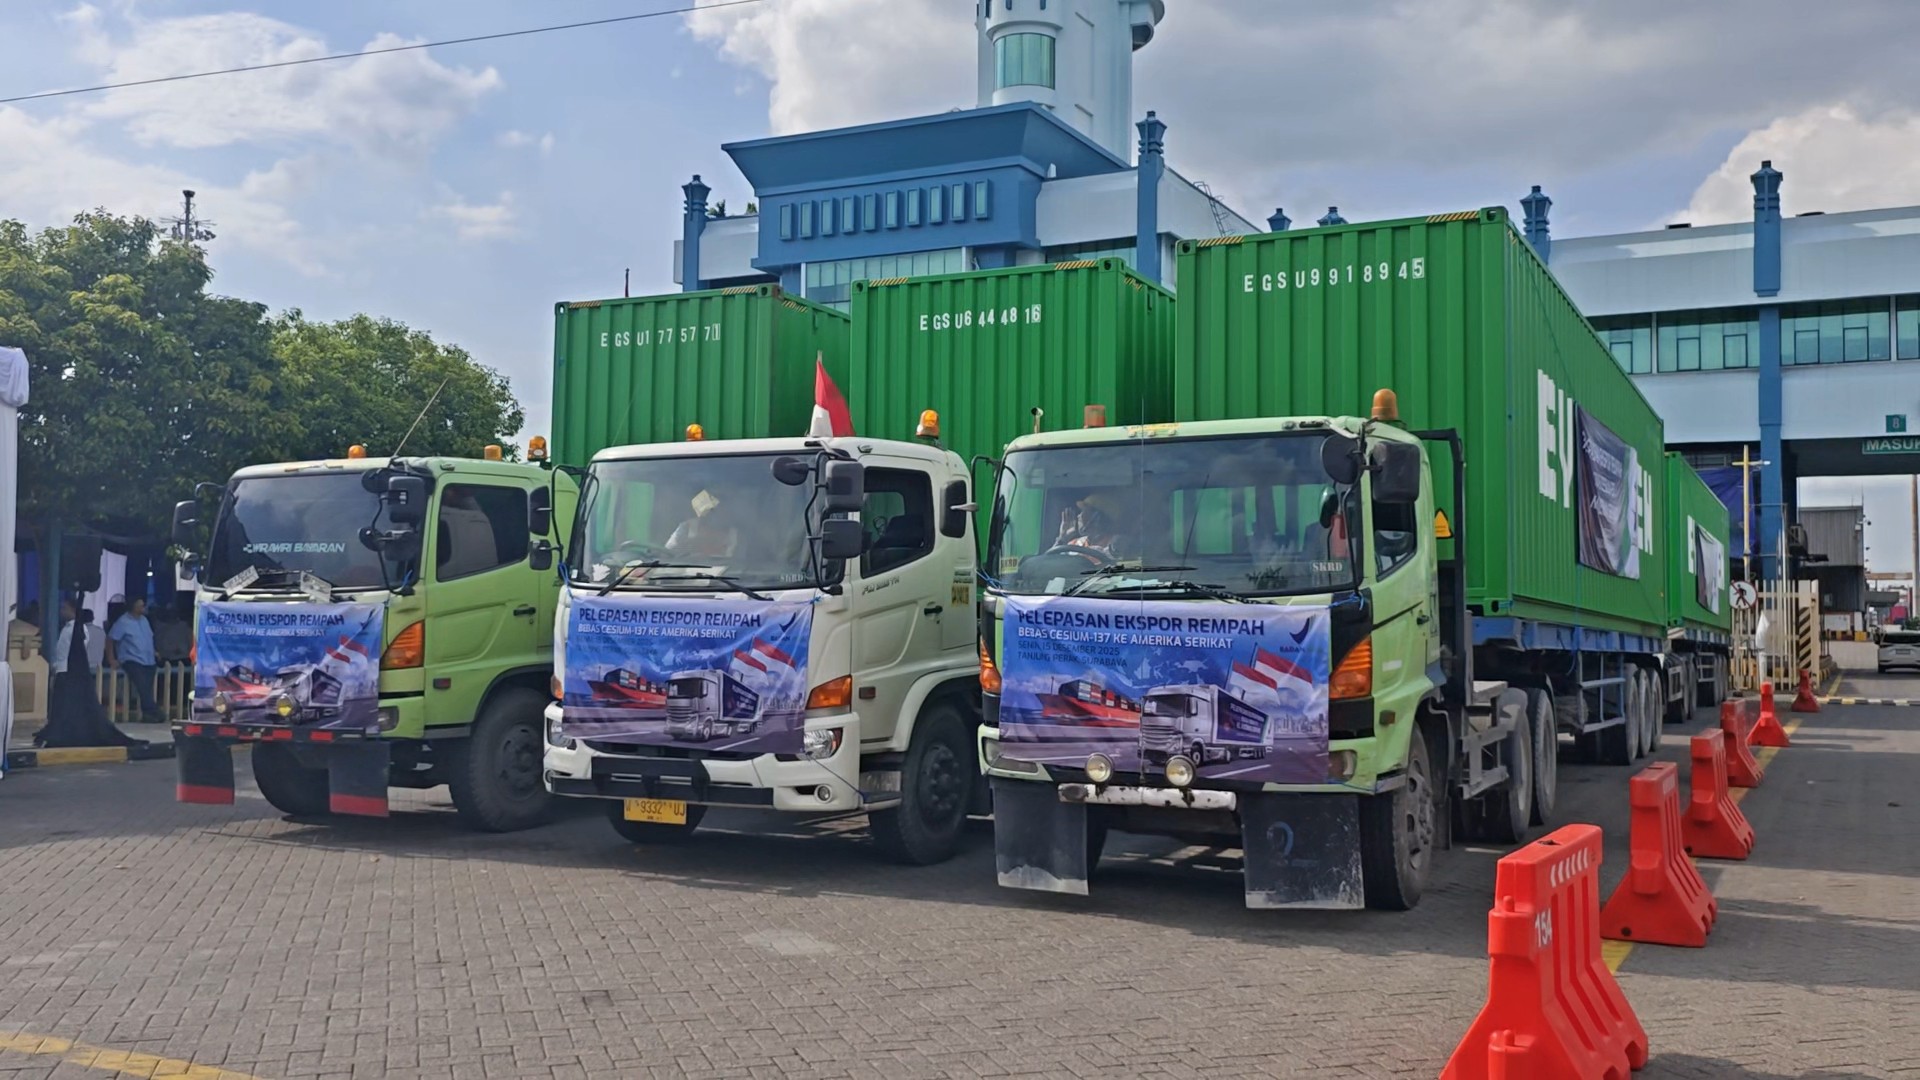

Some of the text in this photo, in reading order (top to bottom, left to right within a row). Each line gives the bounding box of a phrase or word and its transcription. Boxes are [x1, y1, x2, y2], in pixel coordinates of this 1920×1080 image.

[258, 613, 298, 626] EKSPOR
[299, 614, 345, 626] REMPAH
[579, 607, 761, 628] PELEPASAN EKSPOR REMPAH
[1017, 609, 1264, 636] PELEPASAN EKSPOR REMPAH
[601, 624, 647, 636] CESIUM-137
[648, 626, 659, 636] KE
[660, 627, 699, 638] AMERIKA
[700, 628, 737, 639] SERIKAT
[1018, 627, 1233, 649] BEBAS CESIUM-137 KE AMERIKA SERIKAT
